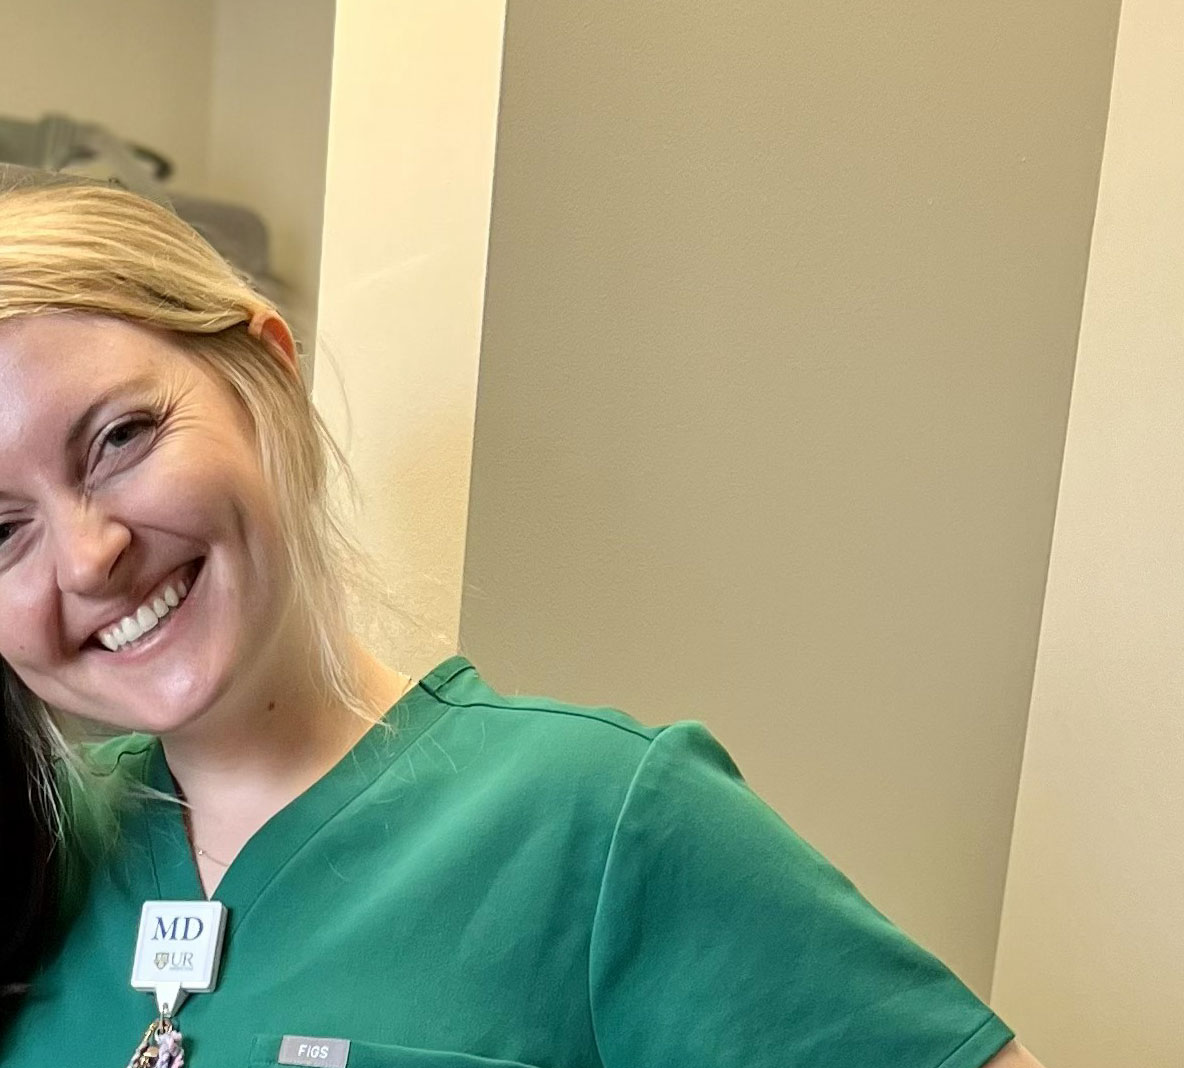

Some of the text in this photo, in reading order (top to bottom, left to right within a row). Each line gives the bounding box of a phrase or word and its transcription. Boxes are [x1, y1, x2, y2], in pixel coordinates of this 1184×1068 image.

[151, 917, 204, 941] MD
[171, 952, 194, 967] UR
[298, 1044, 329, 1059] FIGS
